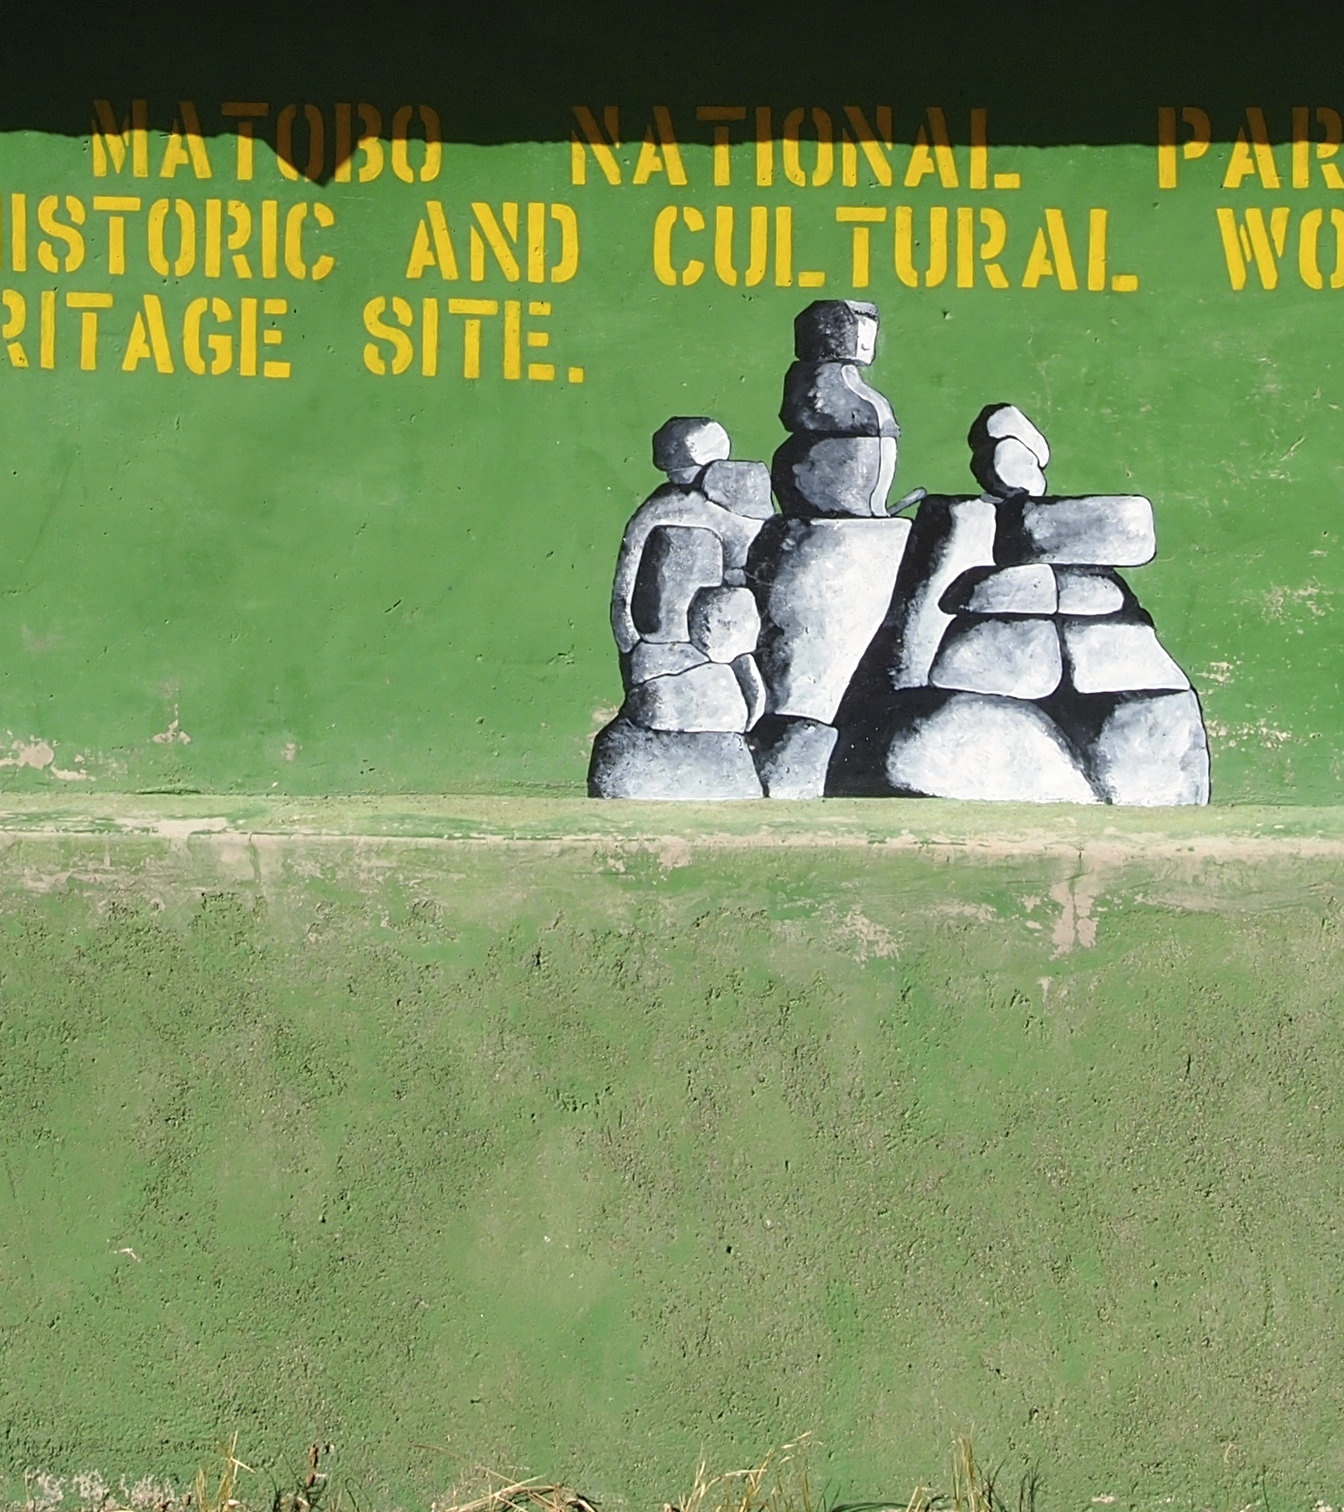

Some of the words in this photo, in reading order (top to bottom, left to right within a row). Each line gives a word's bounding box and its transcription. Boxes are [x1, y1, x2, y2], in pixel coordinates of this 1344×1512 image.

[91, 100, 443, 185] MATOBO
[571, 105, 1022, 190] NATIONAL
[406, 201, 581, 285] AND
[653, 205, 1140, 293] CULTURAL
[363, 296, 585, 384] SITE.
